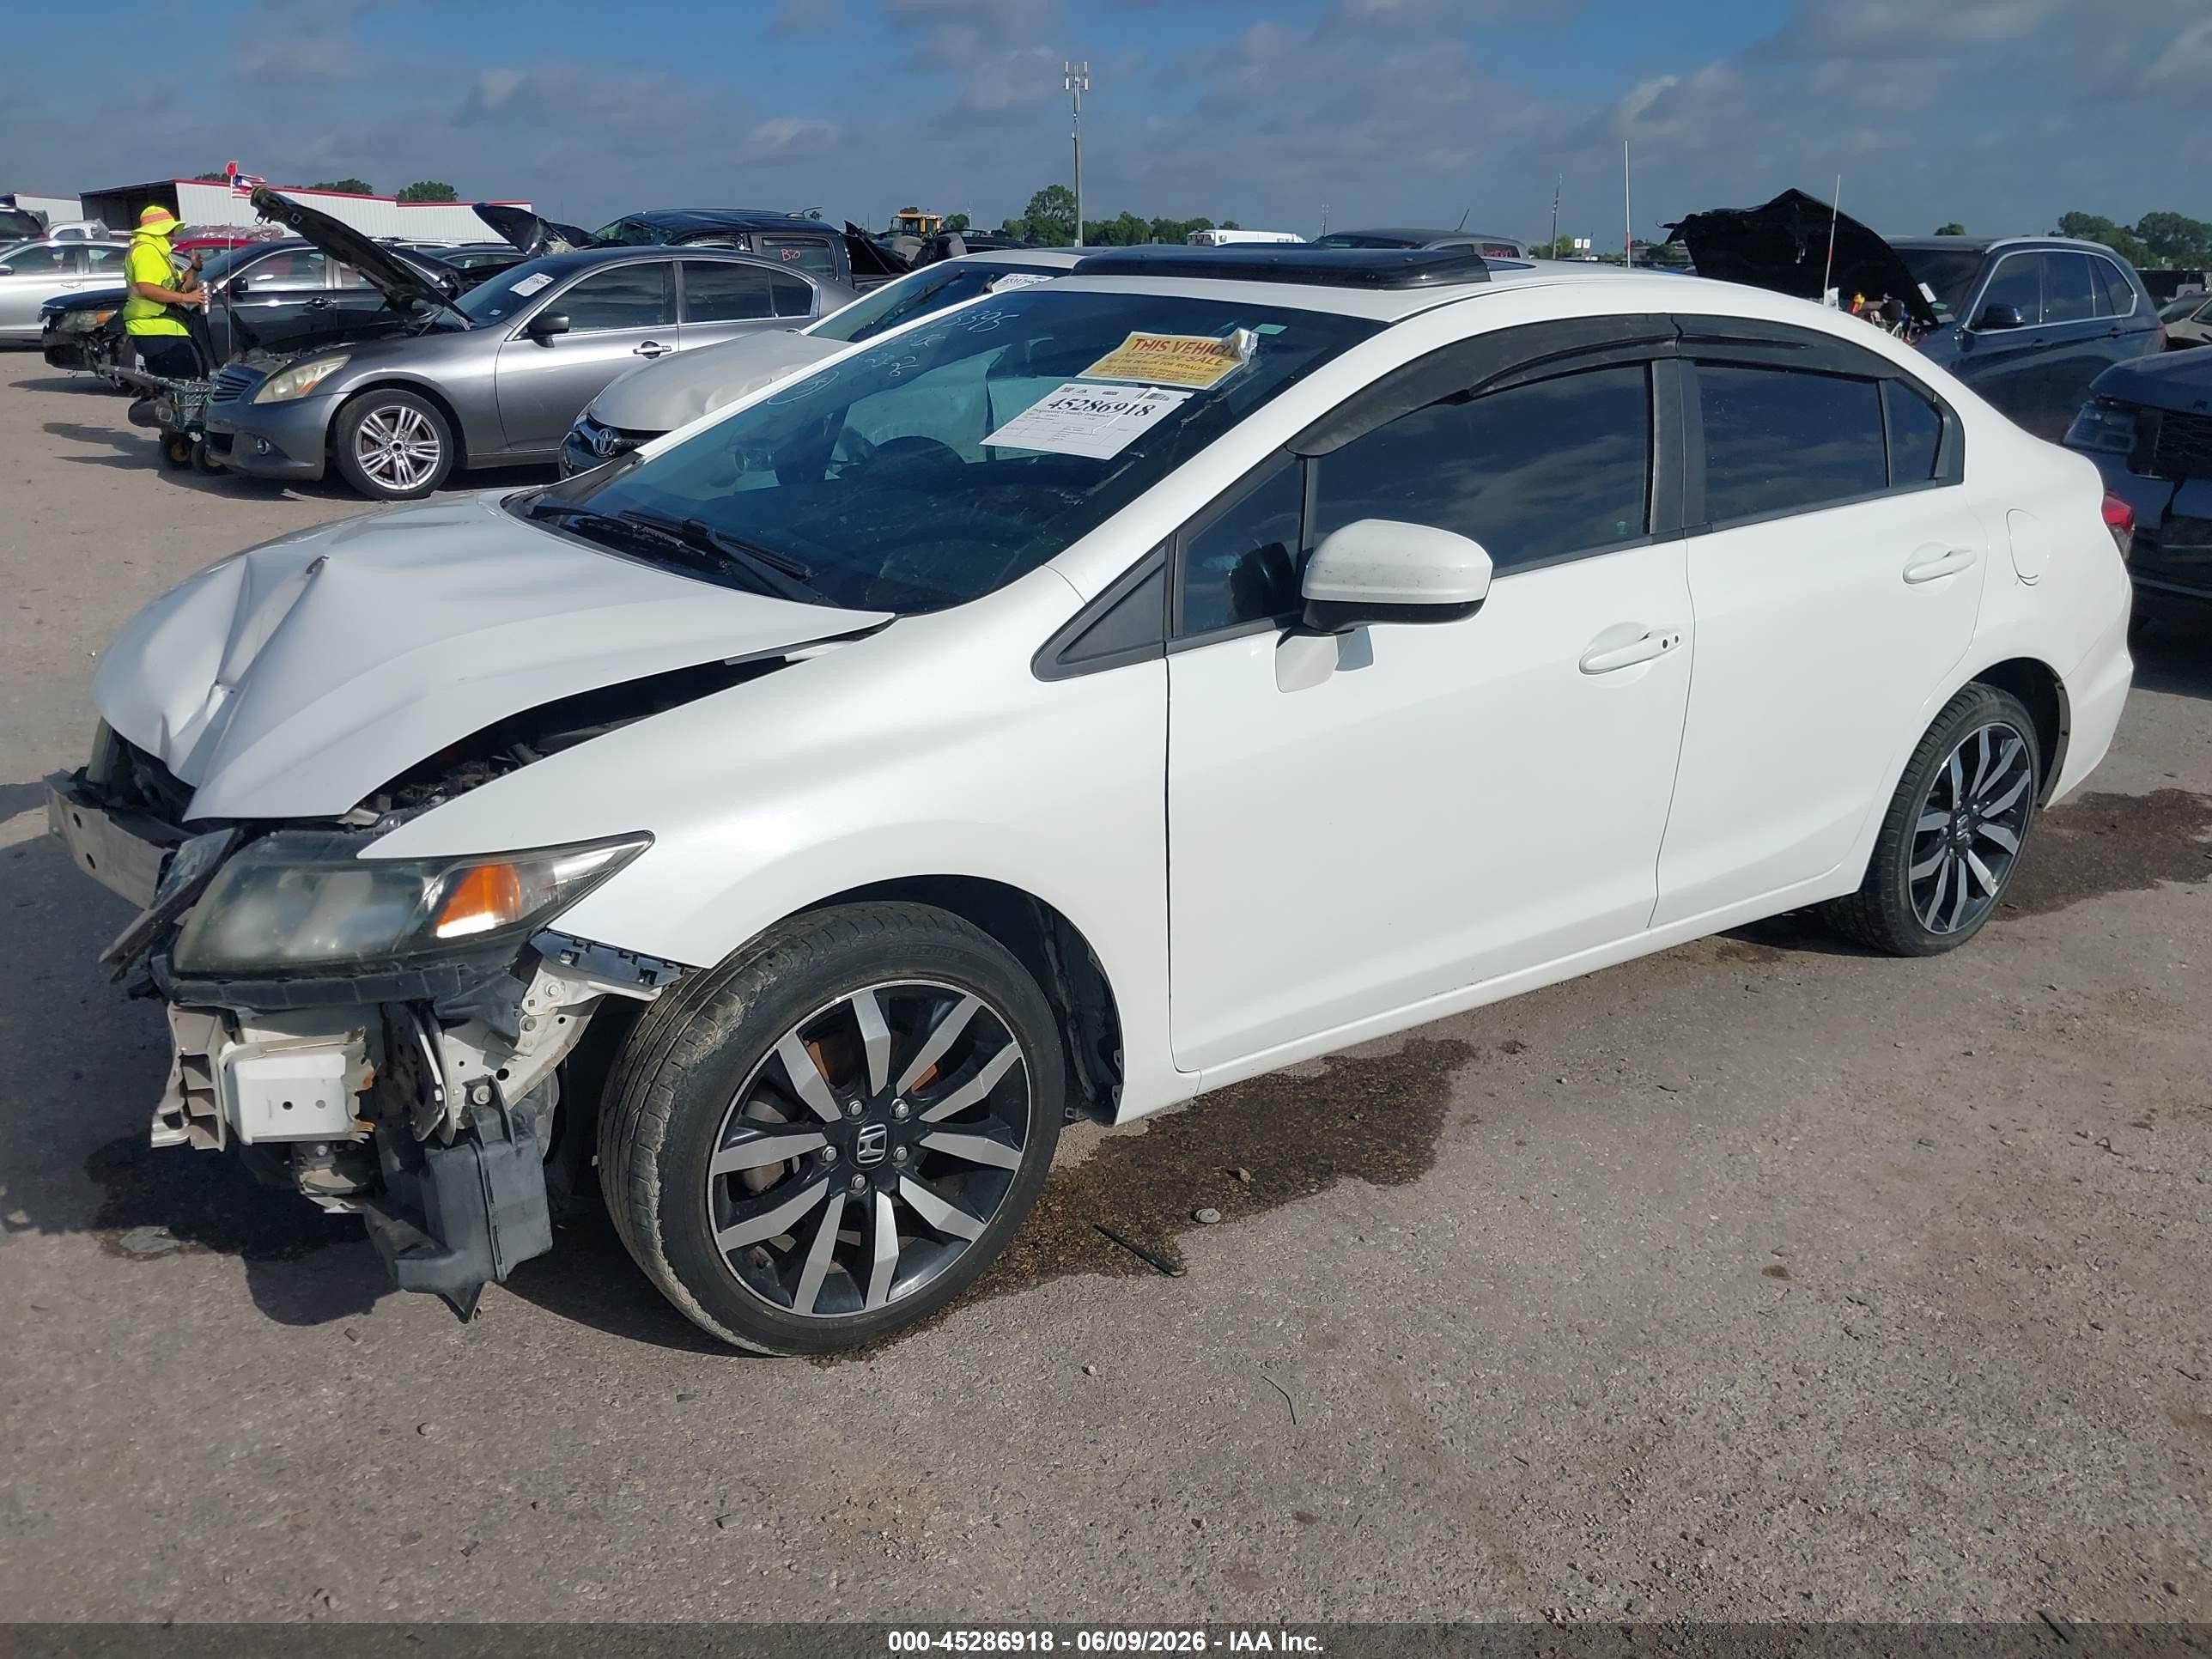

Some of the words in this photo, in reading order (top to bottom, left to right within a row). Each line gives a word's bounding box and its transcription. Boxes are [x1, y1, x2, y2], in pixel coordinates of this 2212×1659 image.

[1131, 338, 1170, 352] THIS
[1186, 355, 1224, 367] SALE
[1047, 398, 1156, 417] 45286918
